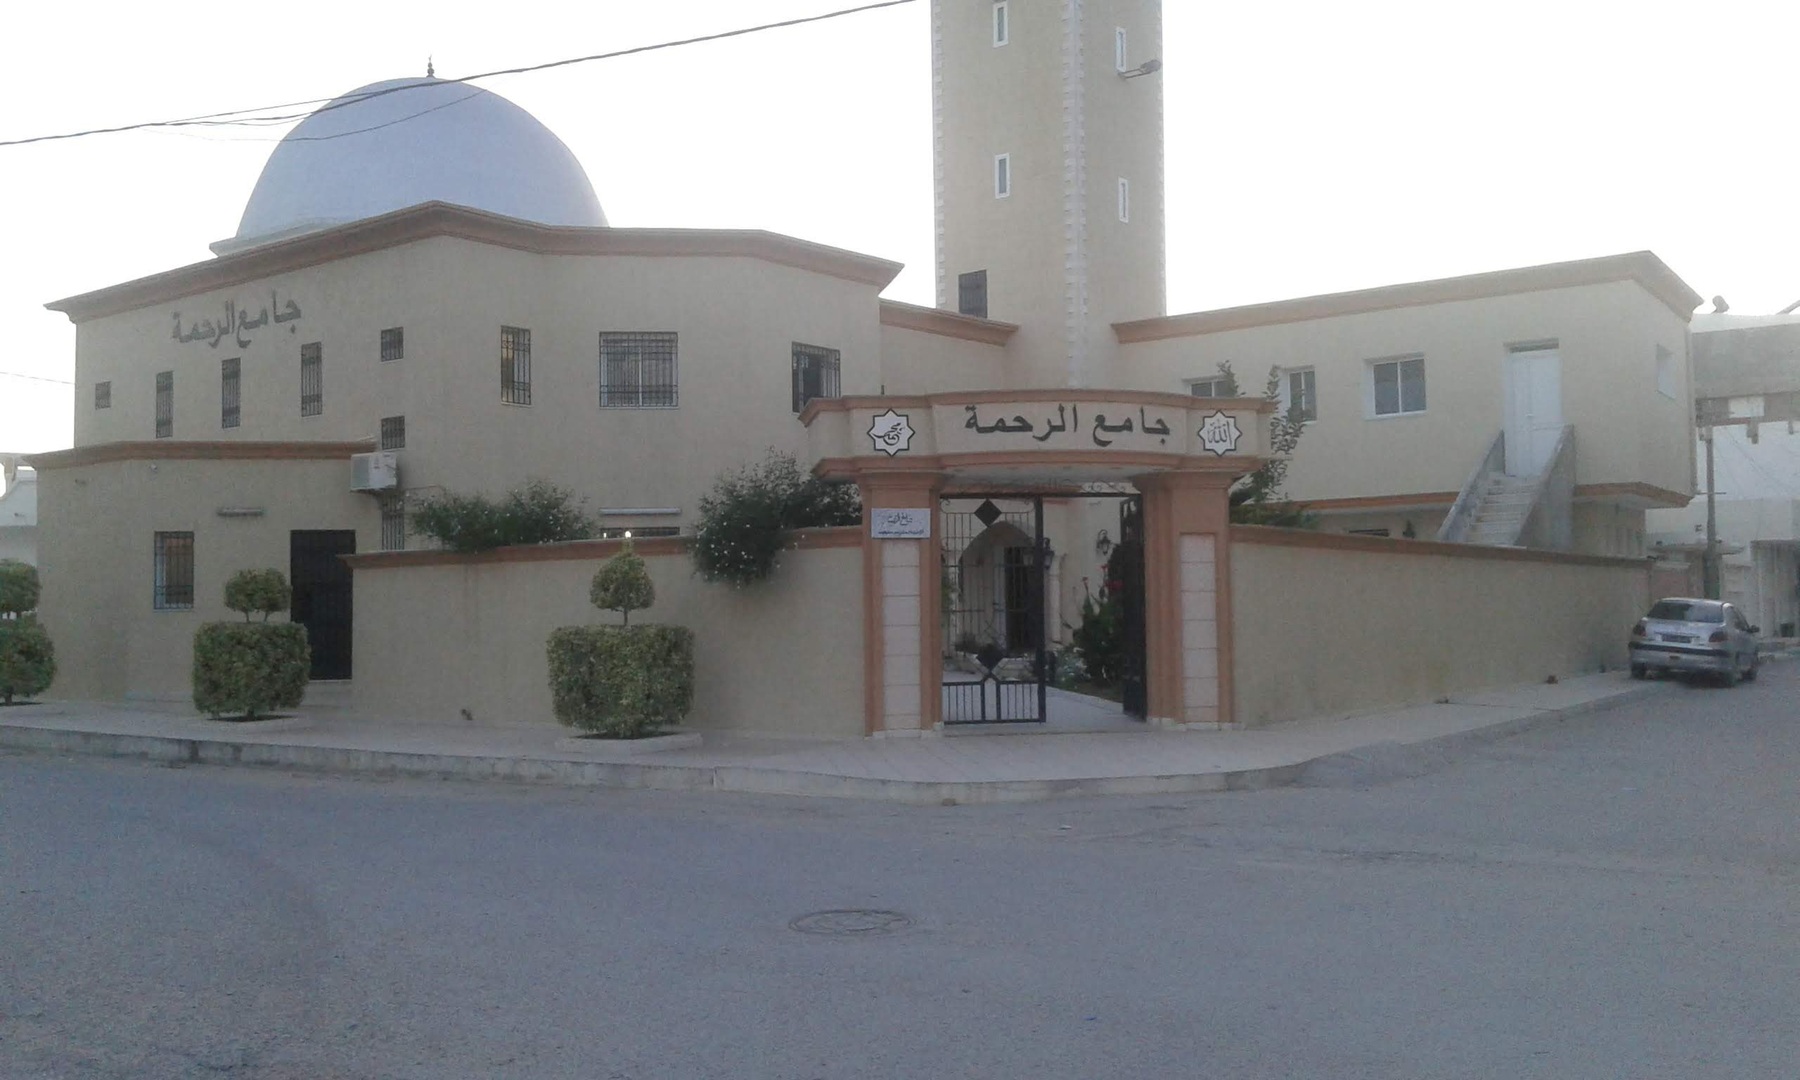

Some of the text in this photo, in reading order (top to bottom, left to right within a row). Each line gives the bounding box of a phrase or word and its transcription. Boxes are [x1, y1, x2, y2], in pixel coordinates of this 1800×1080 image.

[171, 288, 301, 349] جامع الرحمة
[964, 403, 1170, 447] جامع الرحمة
[1207, 418, 1232, 447] الله
